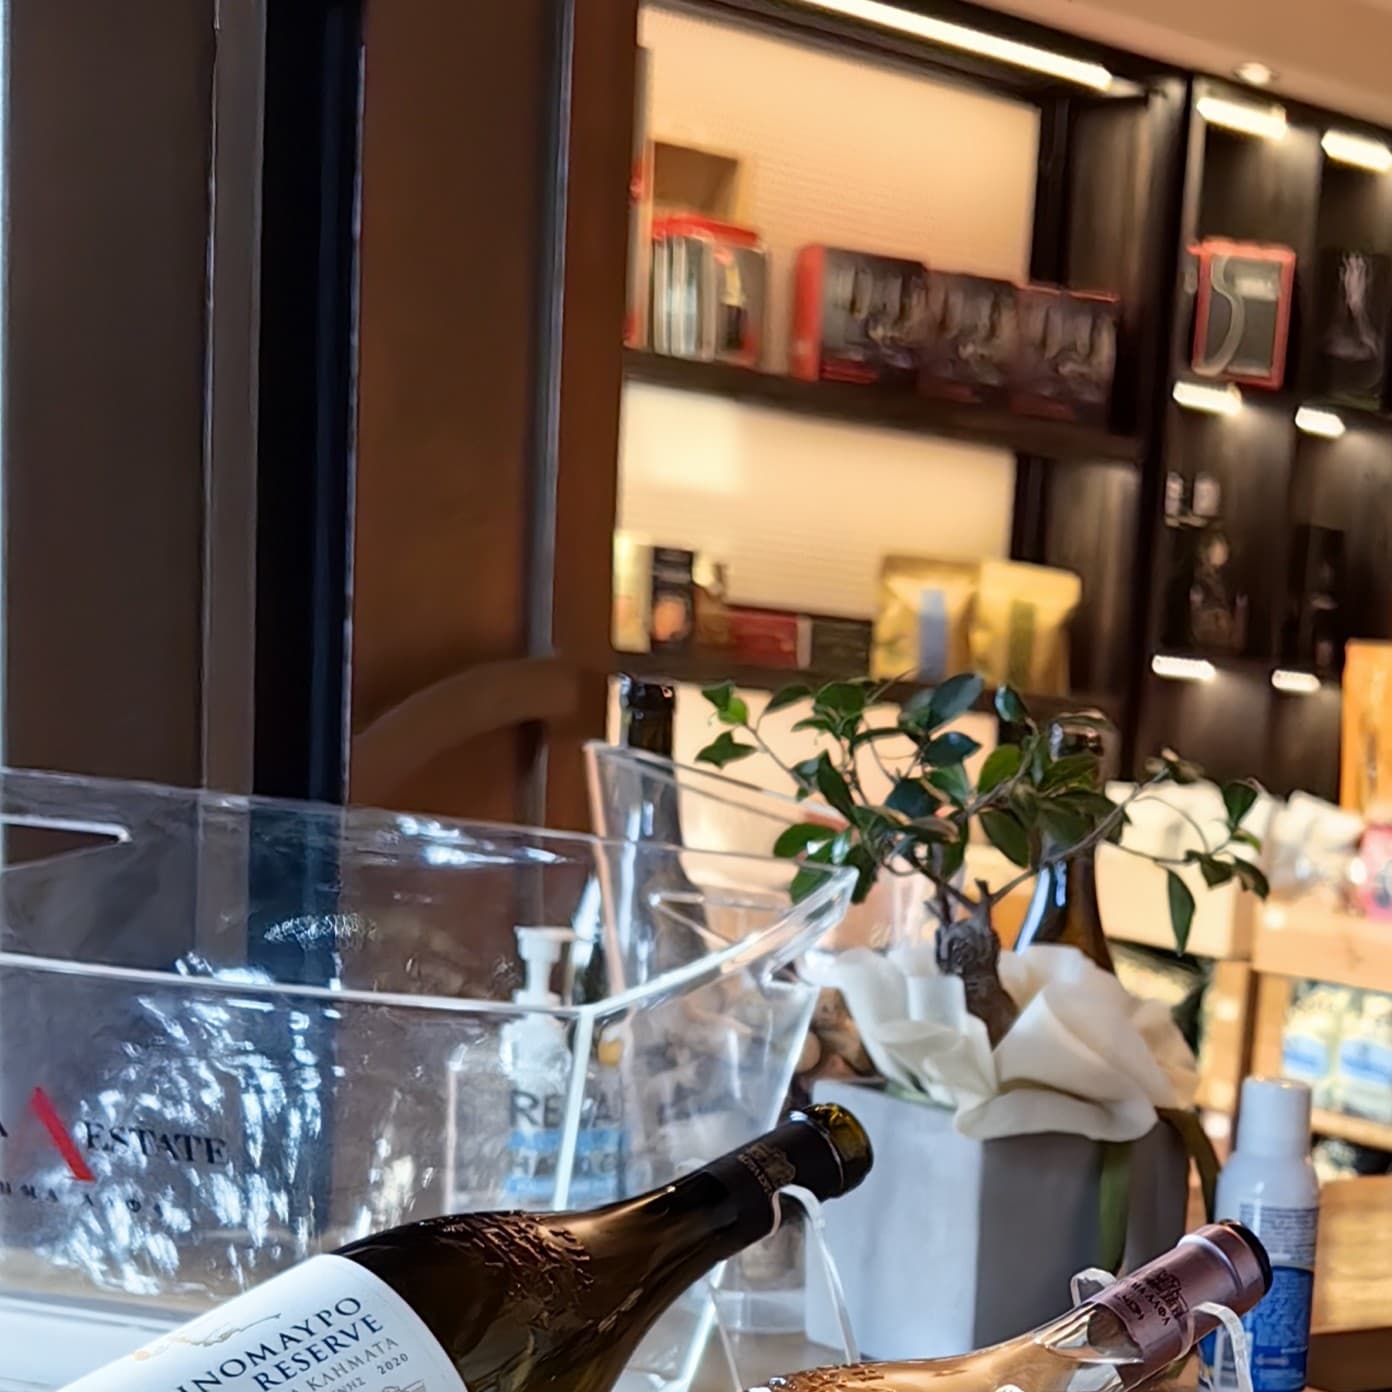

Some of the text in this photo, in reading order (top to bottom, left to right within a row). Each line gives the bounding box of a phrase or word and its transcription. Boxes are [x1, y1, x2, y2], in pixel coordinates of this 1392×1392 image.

[84, 1121, 229, 1165] ESTATE
[252, 1314, 384, 1392] RESERVE
[306, 1337, 400, 1392] ΚΛΗΜΑΤΑ
[376, 1353, 409, 1375] 2020
